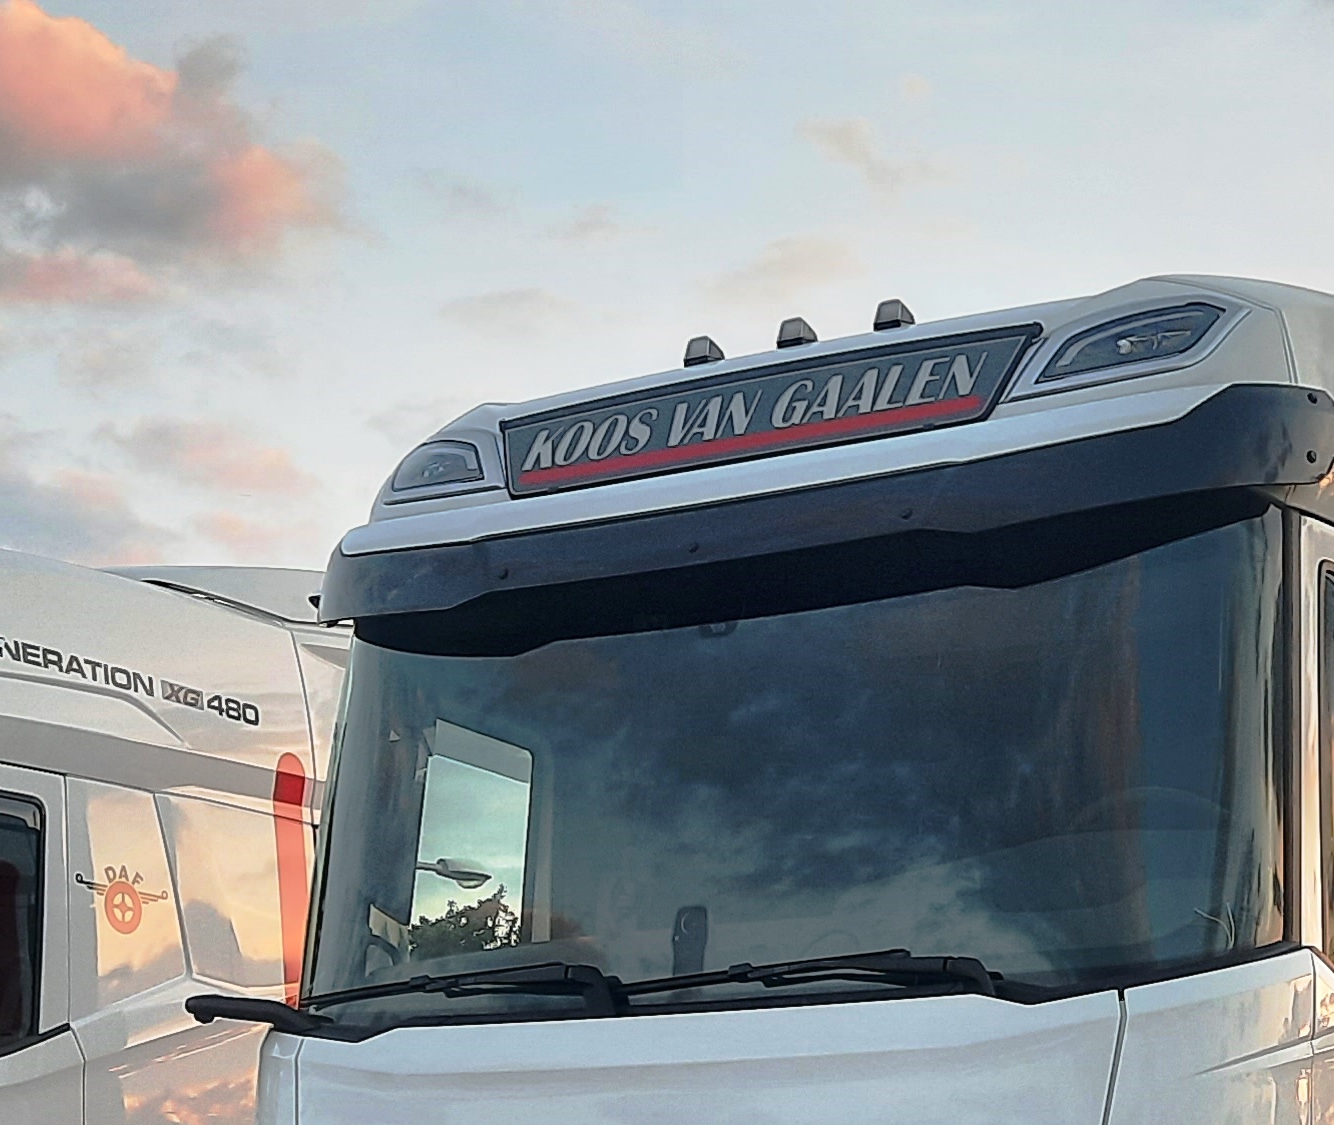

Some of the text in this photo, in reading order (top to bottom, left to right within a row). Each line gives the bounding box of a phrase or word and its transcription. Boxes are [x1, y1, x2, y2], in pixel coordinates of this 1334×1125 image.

[521, 351, 988, 471] KOOS VAN GAALEN
[161, 679, 204, 711] XG
[207, 694, 261, 726] 480
[104, 864, 144, 886] DAF
